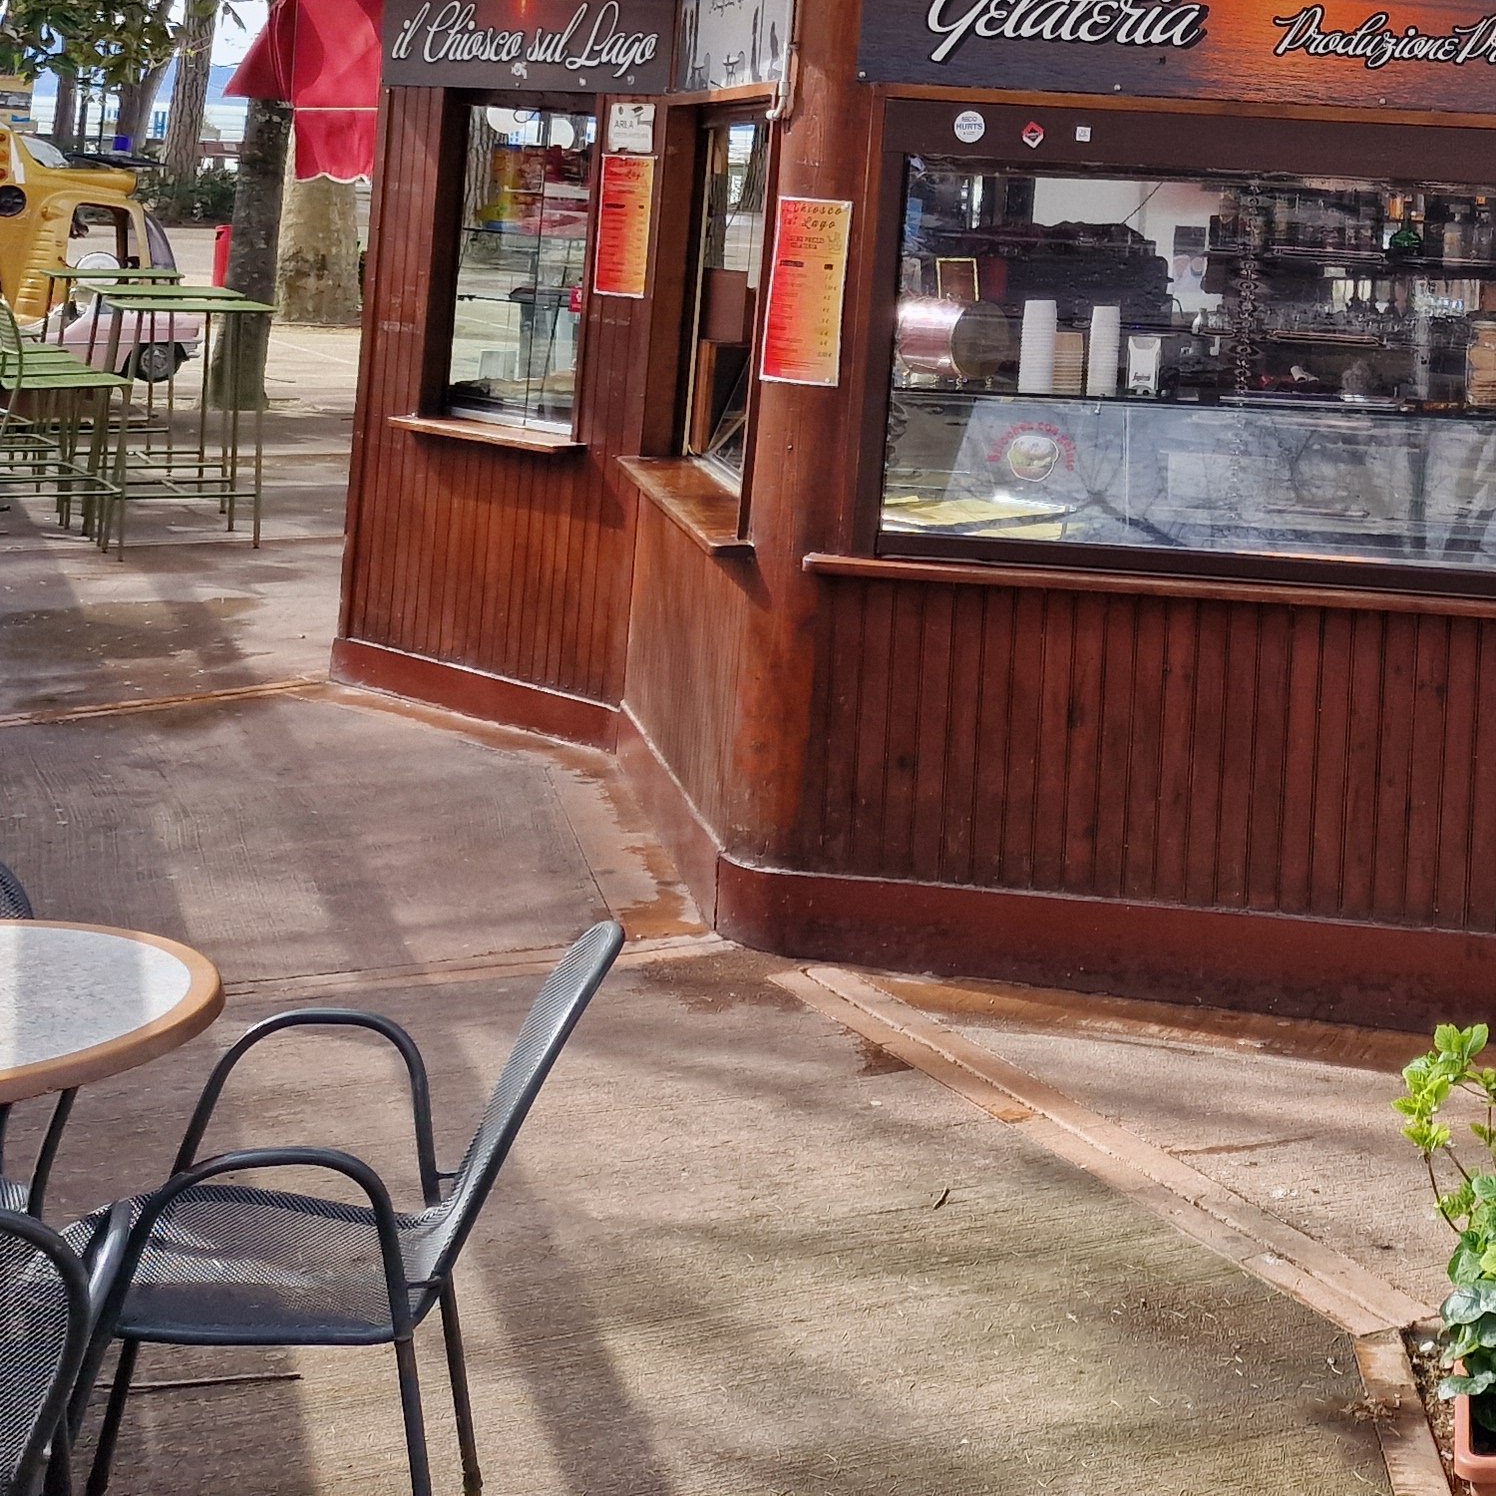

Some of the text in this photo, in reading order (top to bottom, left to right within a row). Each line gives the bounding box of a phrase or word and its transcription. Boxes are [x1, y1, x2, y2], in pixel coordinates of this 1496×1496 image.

[391, 1, 431, 60] il
[423, 0, 525, 64] Chiosco
[526, 2, 588, 64] sul
[565, 0, 660, 78] Lago
[1273, 5, 1457, 70] Produzione
